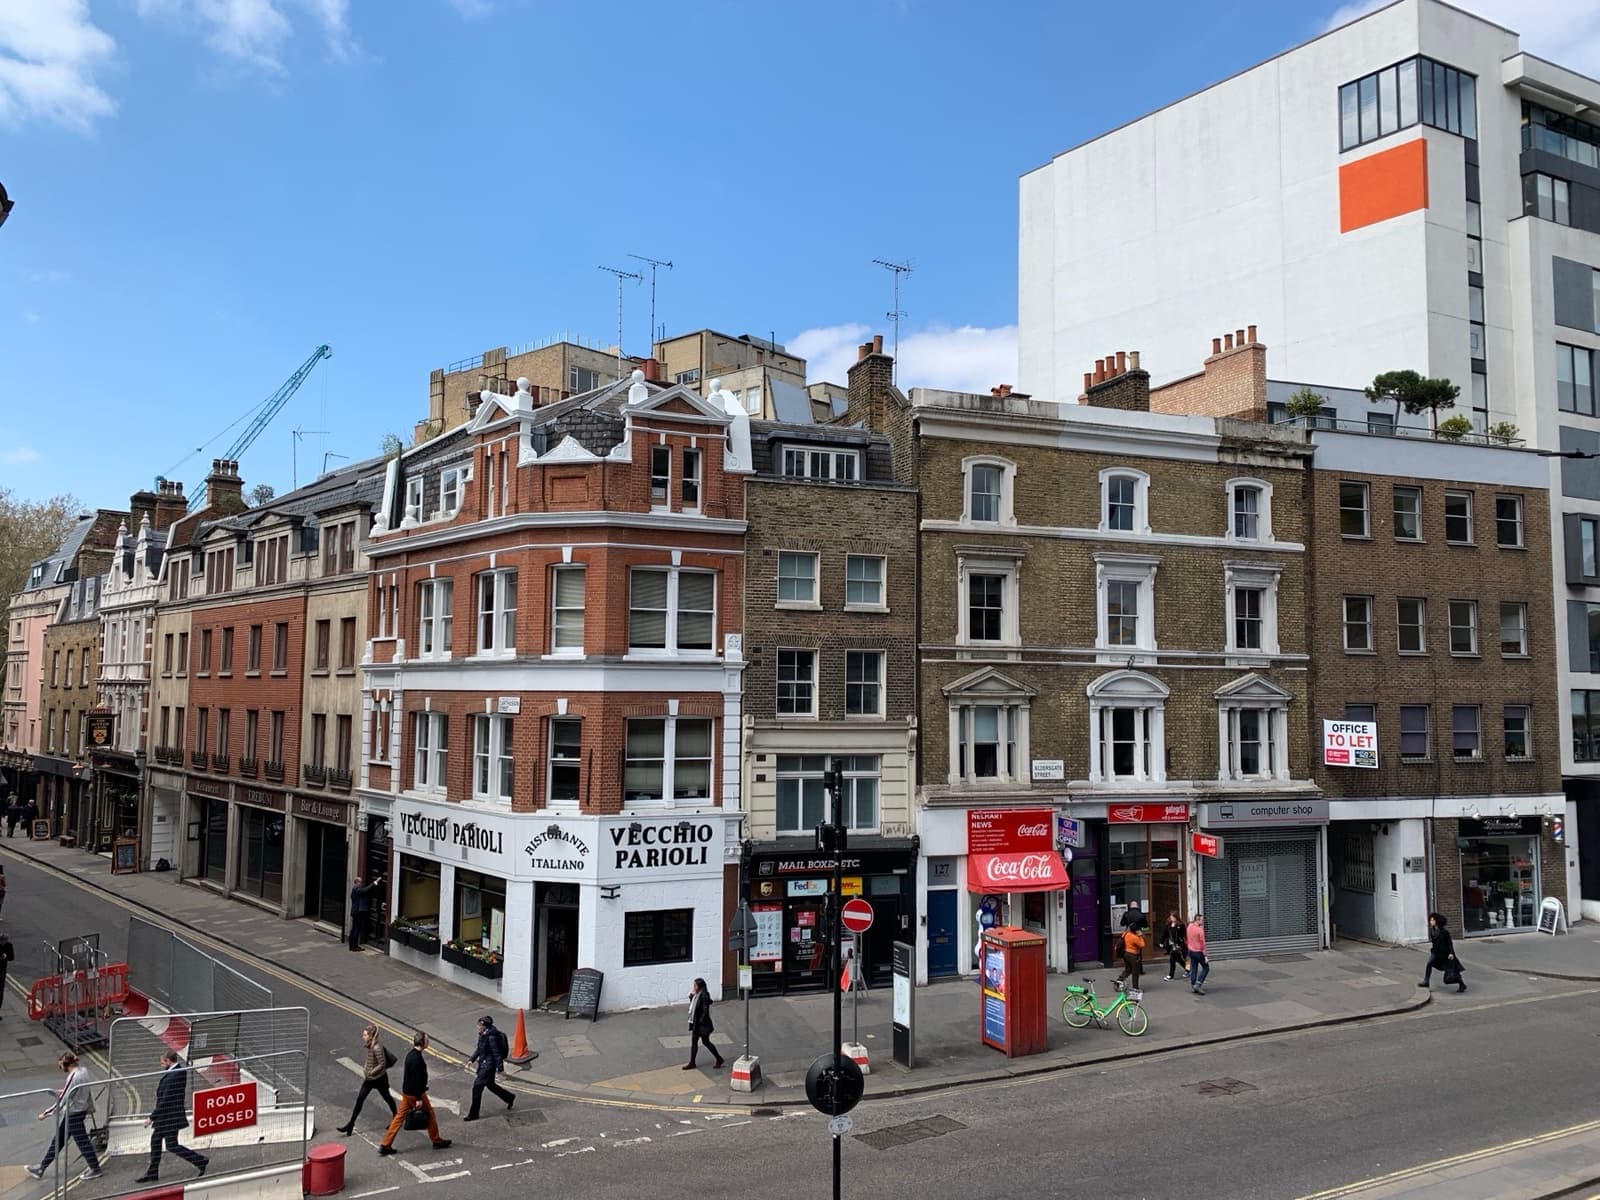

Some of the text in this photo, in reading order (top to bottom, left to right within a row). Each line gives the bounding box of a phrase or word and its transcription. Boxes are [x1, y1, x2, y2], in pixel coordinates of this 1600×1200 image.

[1332, 723, 1369, 734] OFFICE
[1327, 734, 1373, 748] TO LET
[300, 799, 311, 812] Bar
[318, 804, 339, 821] Lounge
[1251, 805, 1312, 816] computer shop
[971, 821, 992, 829] NEWS
[400, 812, 503, 854] VECCHIO PARIOLI
[609, 824, 713, 846] VECCHIO
[524, 828, 589, 857] RISTORANTE
[531, 858, 585, 870] ITALIANO
[615, 846, 708, 869] PARIOLI
[778, 861, 805, 870] MAIL
[808, 860, 839, 868] BOXE
[934, 864, 949, 874] 127
[987, 854, 1053, 880] Coca-Cola
[794, 881, 818, 890] FedEx
[206, 1093, 245, 1109] ROAD
[198, 1109, 254, 1128] CLOSED
